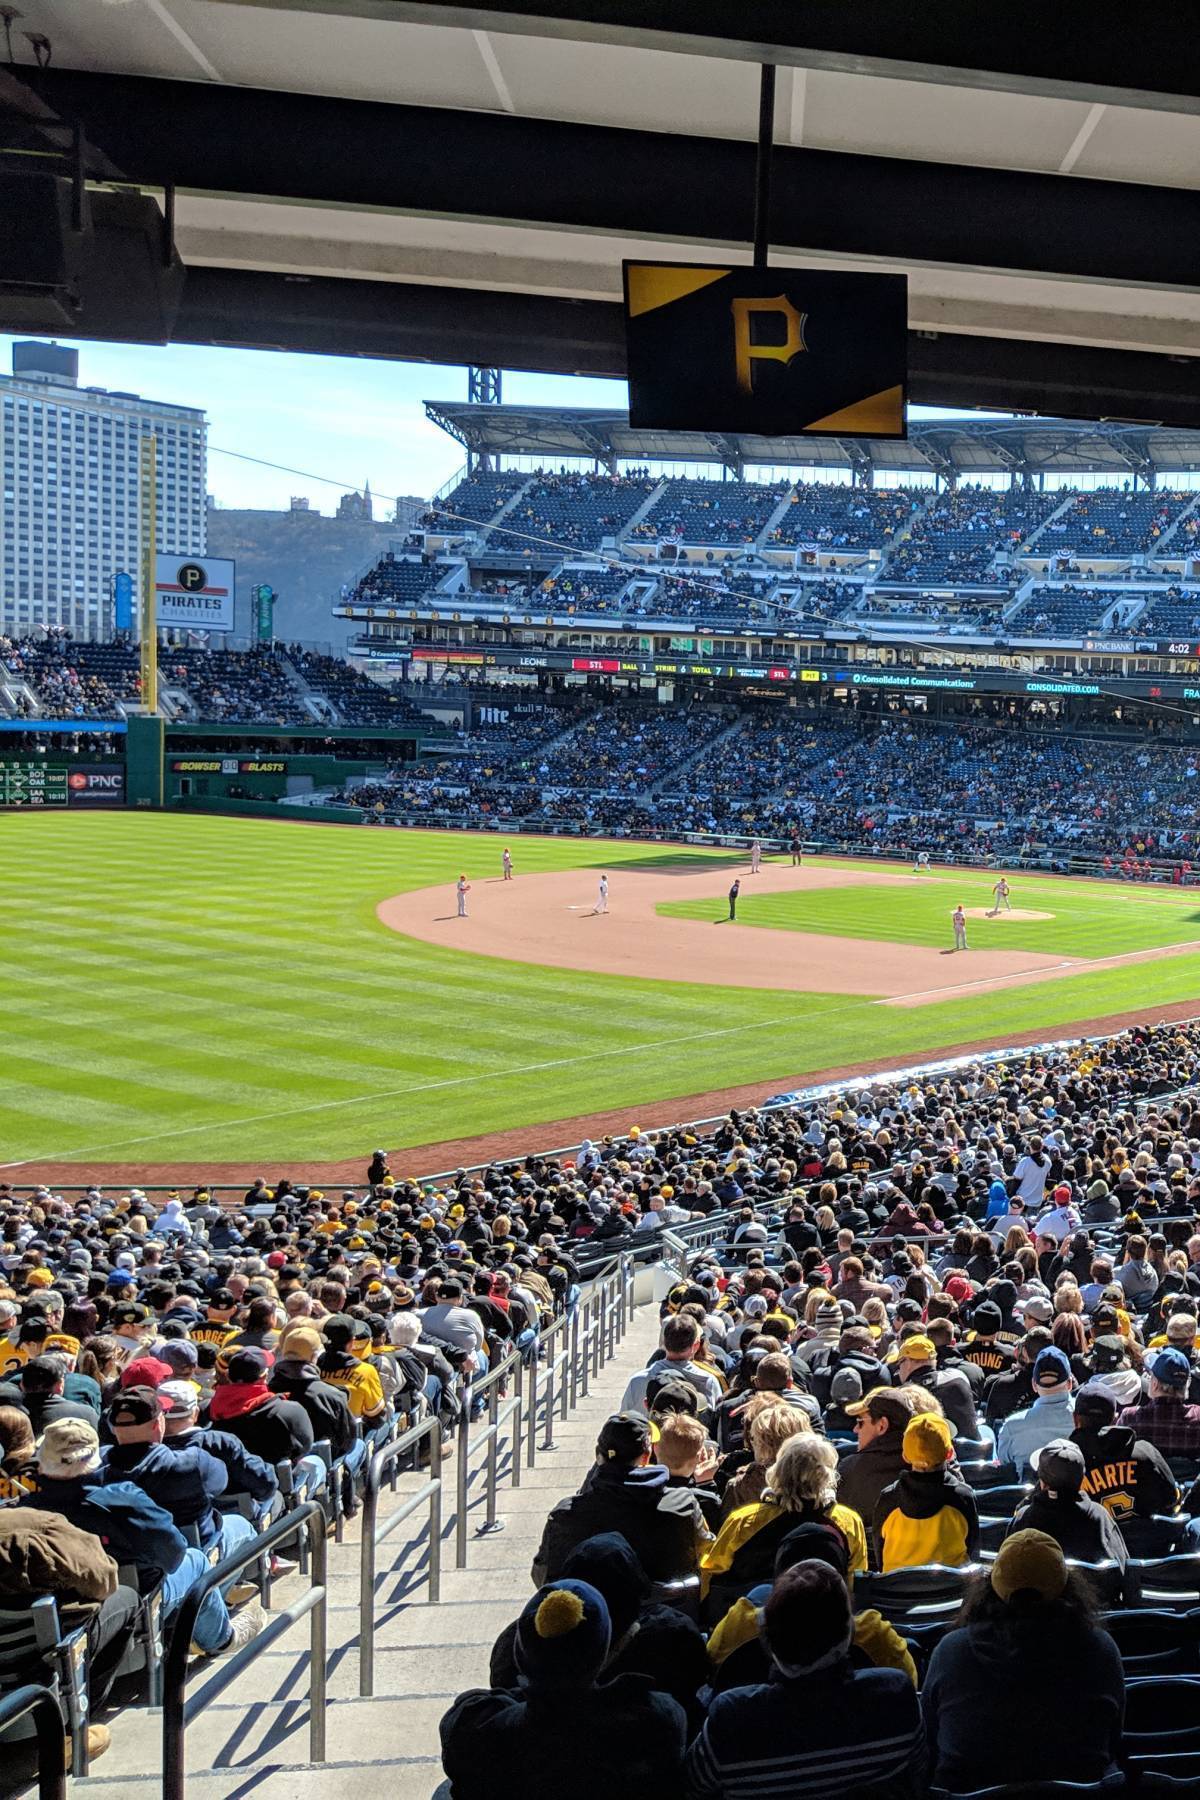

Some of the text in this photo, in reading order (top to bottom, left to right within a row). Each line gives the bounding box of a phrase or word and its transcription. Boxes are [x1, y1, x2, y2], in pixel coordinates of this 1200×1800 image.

[731, 294, 808, 394] P
[186, 569, 200, 587] P
[162, 594, 222, 611] PIRATES
[161, 606, 222, 619] CHARITIES
[1168, 643, 1190, 654] 4:02
[520, 657, 548, 666] LEONE
[589, 661, 604, 669] STL
[642, 663, 647, 671] 1
[655, 665, 676, 673] STRIKE
[680, 665, 687, 673] 6
[692, 666, 712, 674] TOTAL
[716, 667, 722, 675] 7
[790, 671, 797, 679] 4
[822, 672, 828, 680] 3
[861, 674, 974, 689] Consolidated Communications
[1026, 682, 1099, 695] CONSOLIDATED.COM
[513, 703, 534, 713] skull
[180, 762, 221, 771] BOWSER
[248, 762, 284, 772] BLASTS
[89, 775, 123, 788] PNC
[966, 1352, 1003, 1370] YOUNG
[1079, 1460, 1138, 1495] MARTE
